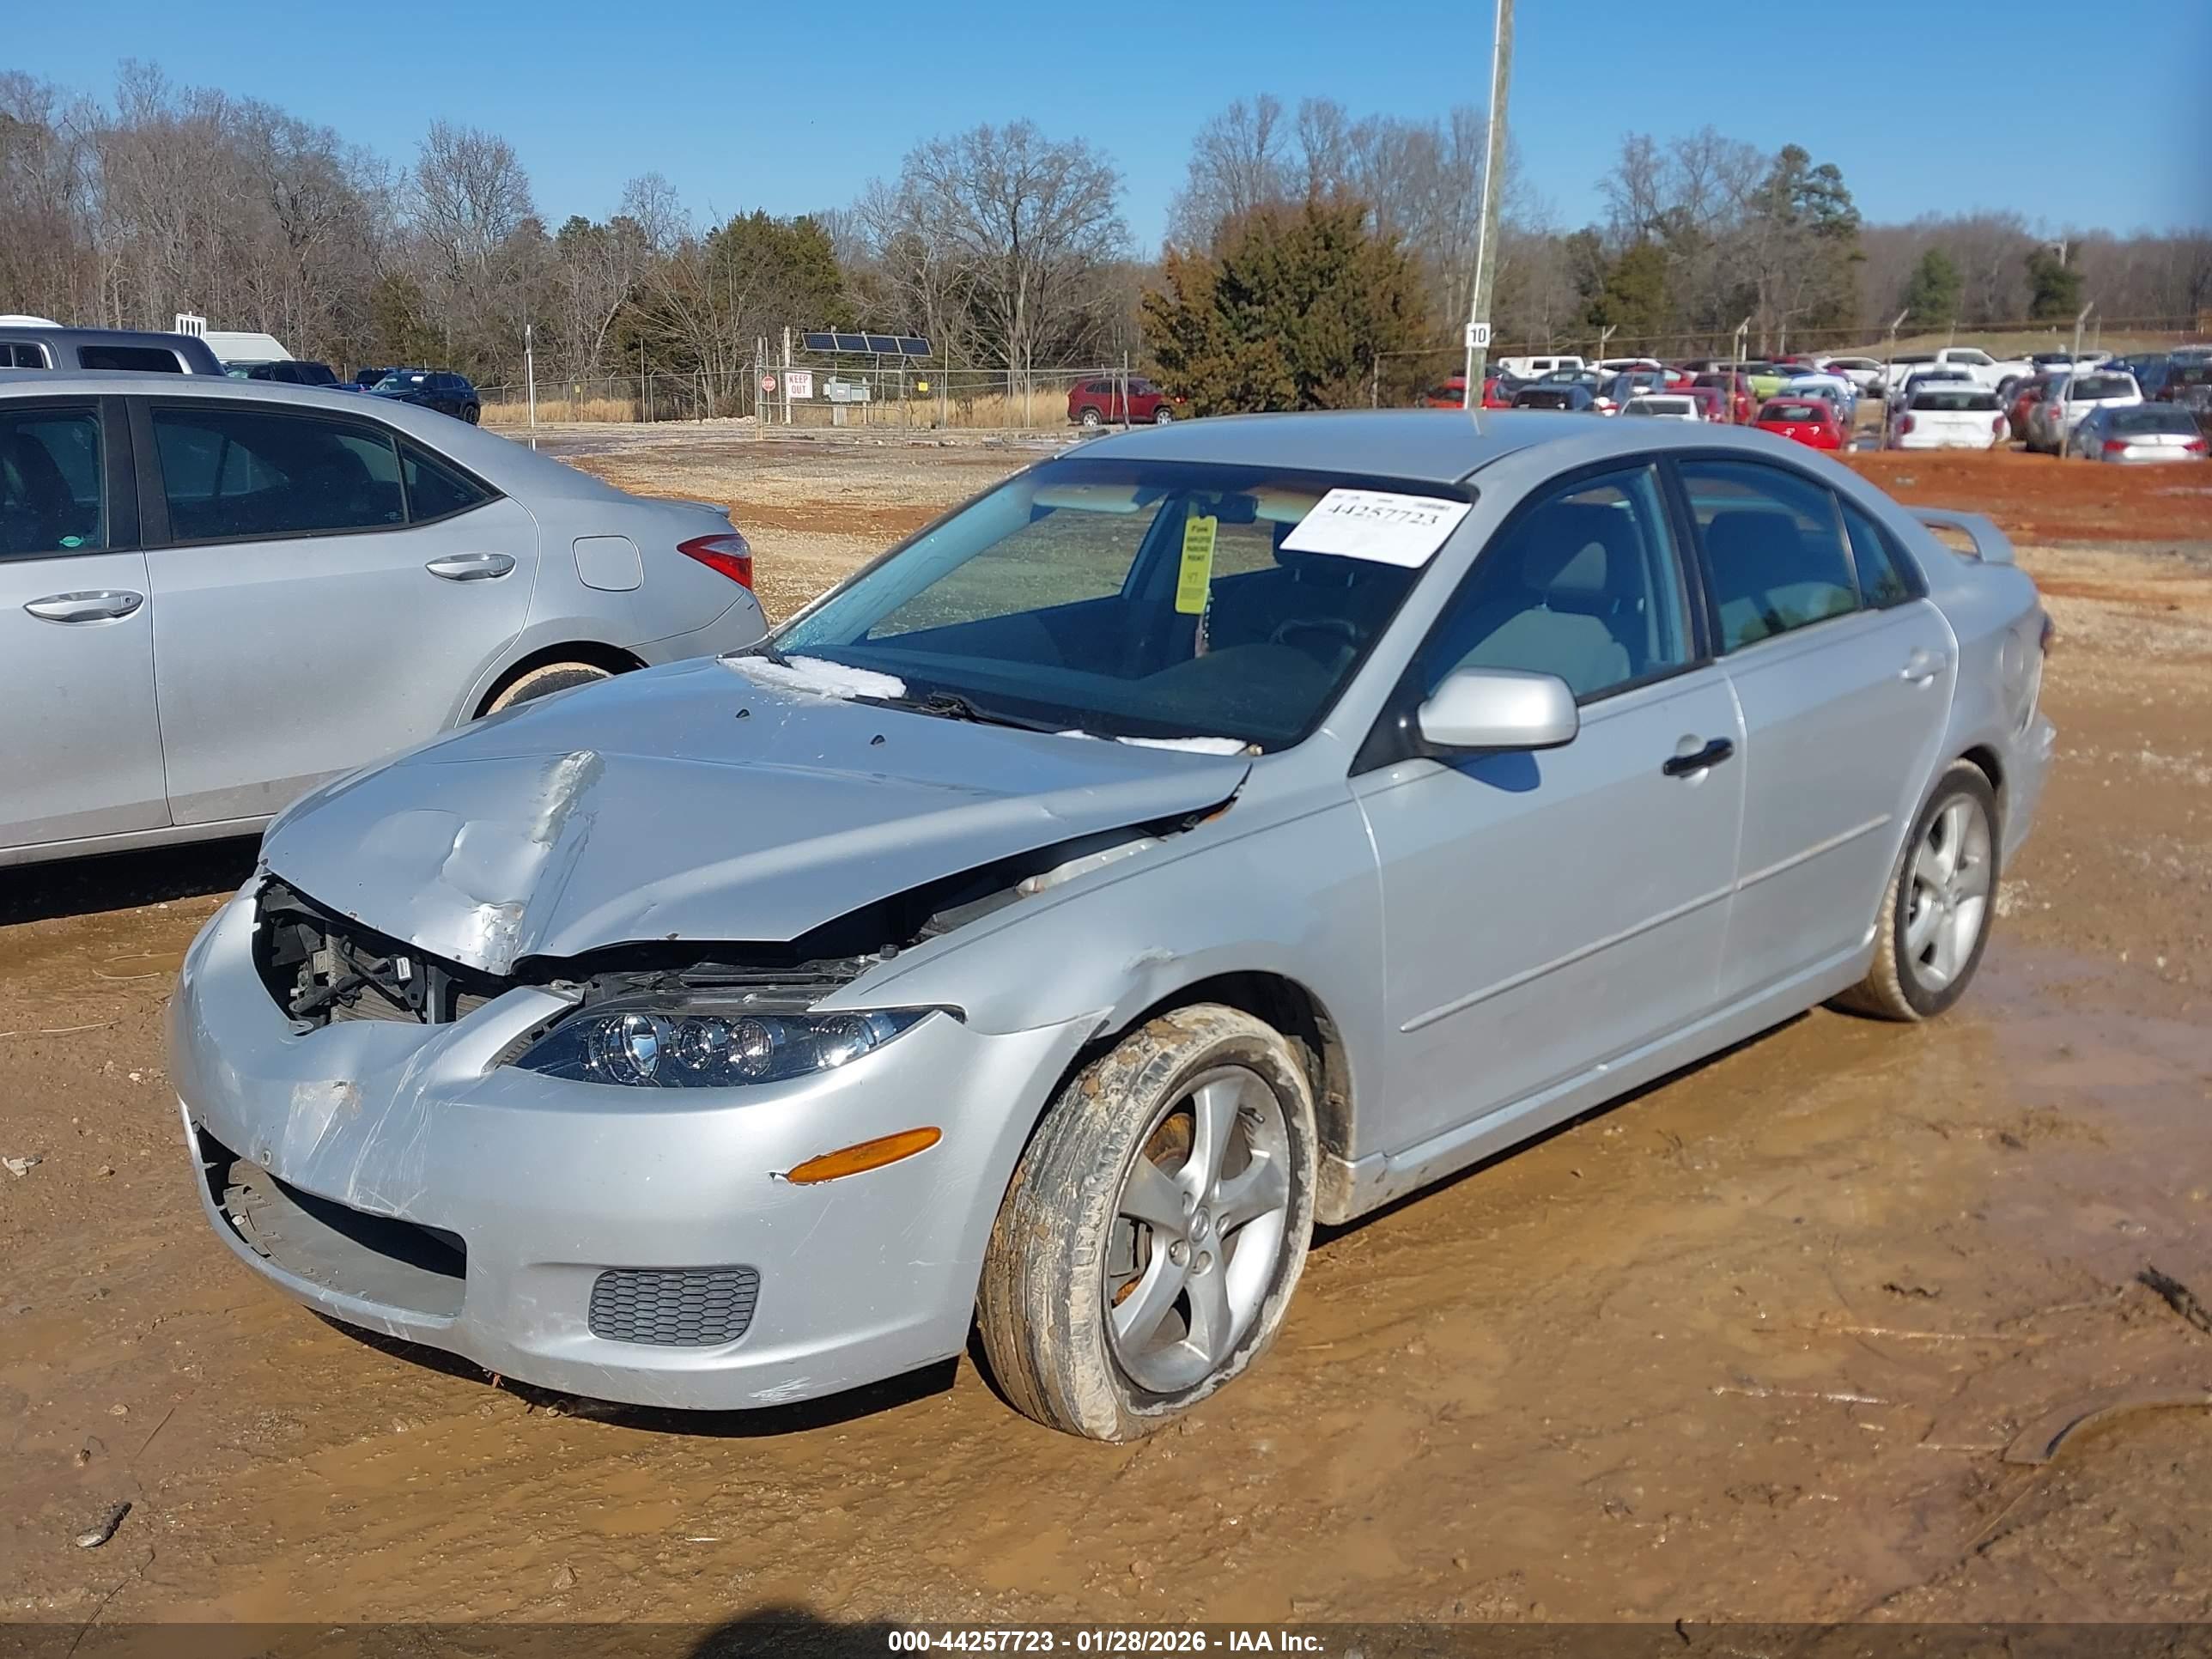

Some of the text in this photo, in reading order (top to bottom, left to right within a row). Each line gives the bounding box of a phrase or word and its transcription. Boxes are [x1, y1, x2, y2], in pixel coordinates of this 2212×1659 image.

[1470, 328, 1486, 343] 10
[789, 374, 809, 384] KEEP
[791, 386, 806, 395] OUT
[1328, 503, 1440, 526] 44257723
